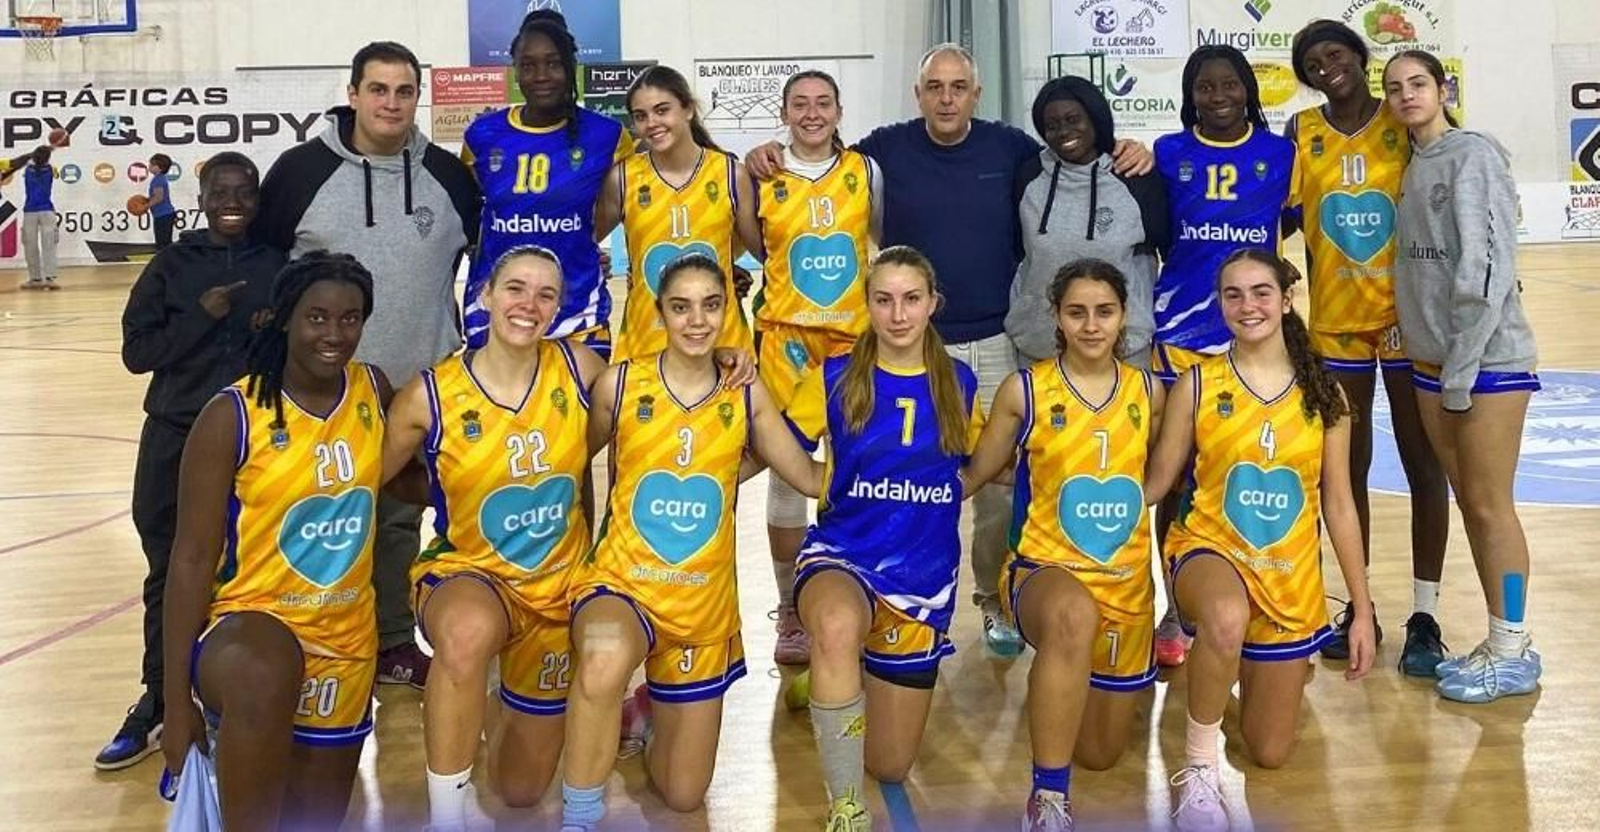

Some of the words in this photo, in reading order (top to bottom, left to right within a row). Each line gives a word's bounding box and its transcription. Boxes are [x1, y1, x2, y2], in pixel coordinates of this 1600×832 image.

[1092, 37, 1106, 46] EL
[1108, 36, 1156, 46] LECHERO
[1197, 28, 1292, 52] Murgiver
[453, 73, 504, 82] MAPFRE
[700, 65, 751, 77] BLANQUEO
[754, 65, 760, 76] Y
[762, 64, 800, 76] LAVADO
[10, 83, 228, 109] GRÁFICAS
[719, 78, 781, 94] CLARES
[1572, 82, 1600, 110] C
[1107, 98, 1176, 112] ICTORIA
[4, 116, 86, 148] PY
[155, 113, 322, 145] COPY
[105, 120, 117, 135] 2
[513, 153, 550, 194] 18
[1205, 163, 1238, 200] 12
[1340, 154, 1367, 187] 10
[1571, 185, 1600, 196] BLANQU
[1572, 197, 1600, 208] CLAR
[102, 211, 129, 232] 33
[671, 204, 691, 238] 11
[808, 195, 834, 228] 13
[1335, 210, 1382, 227] cara
[801, 255, 846, 271] cara
[896, 397, 917, 446] 7
[675, 427, 694, 467] 3
[1093, 430, 1110, 470] 7
[1259, 420, 1276, 461] 4
[315, 439, 355, 488] 20
[505, 430, 552, 479] 22
[650, 498, 707, 519] cara
[1075, 501, 1128, 519] cara
[1238, 489, 1289, 509] cara
[301, 515, 363, 540] cara
[503, 502, 564, 532] cara
[1105, 629, 1120, 668] 7
[538, 652, 571, 691] 22
[296, 676, 339, 718] 20
